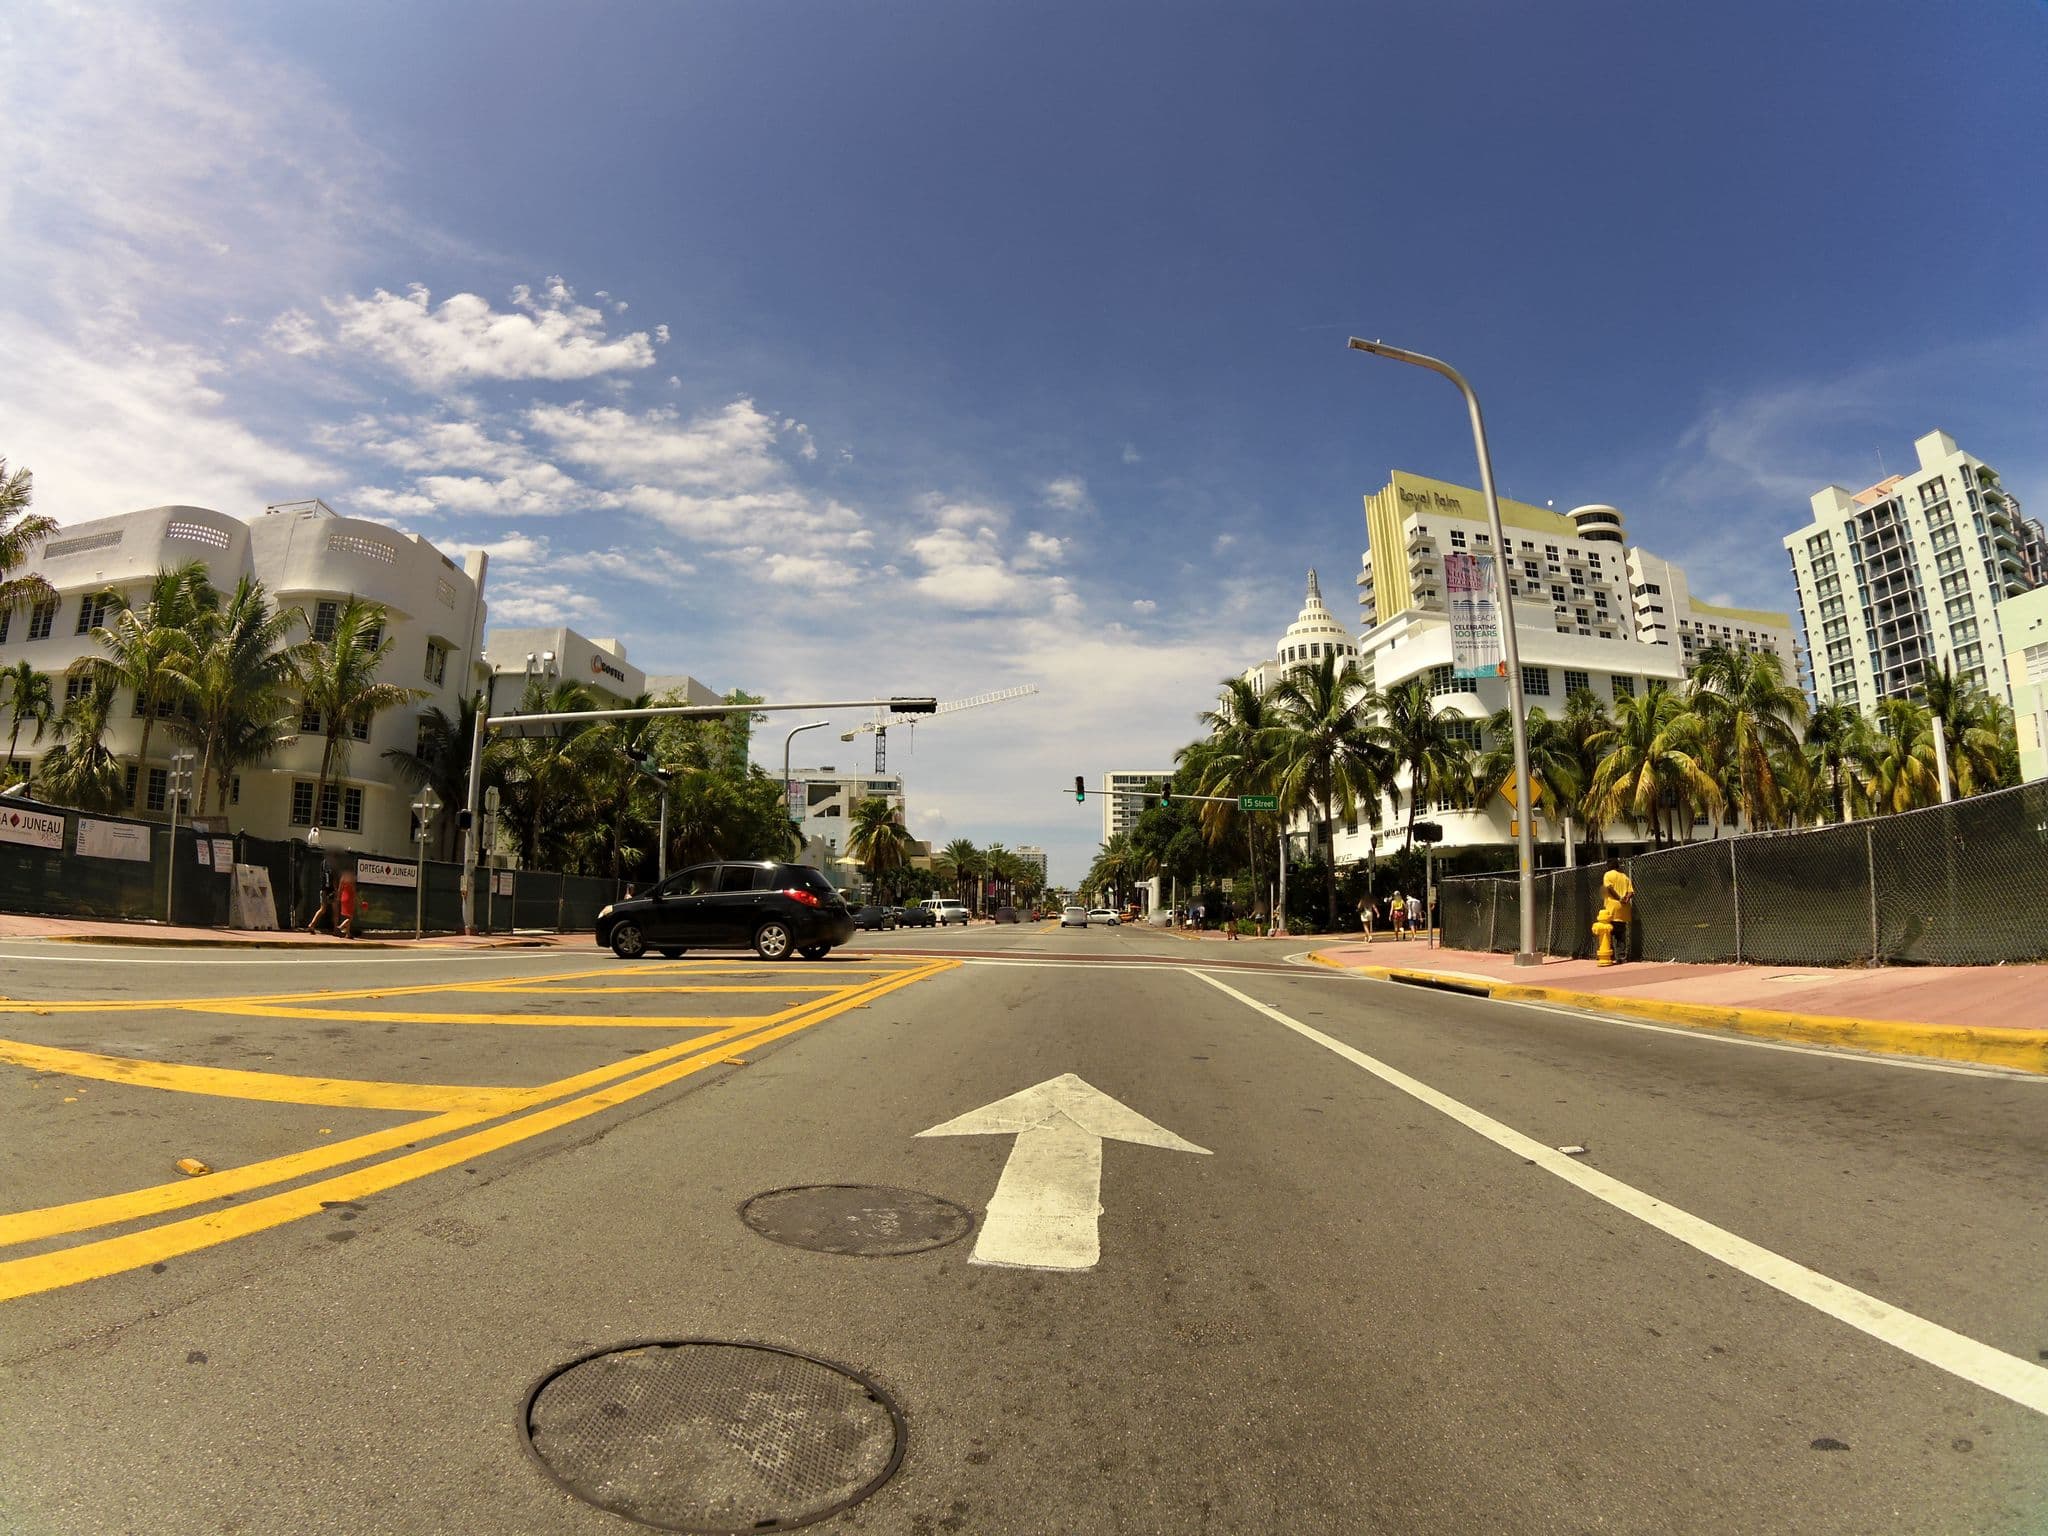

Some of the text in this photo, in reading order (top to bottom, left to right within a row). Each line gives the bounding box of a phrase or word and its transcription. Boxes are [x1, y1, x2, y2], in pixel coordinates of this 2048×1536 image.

[1399, 486, 1463, 514] Royal Palm
[1454, 630, 1497, 638] 100 YEARS
[1244, 798, 1274, 808] 15 Street
[22, 815, 61, 834] JUNEAU
[360, 863, 416, 878] ORTEGA JUNEAU
